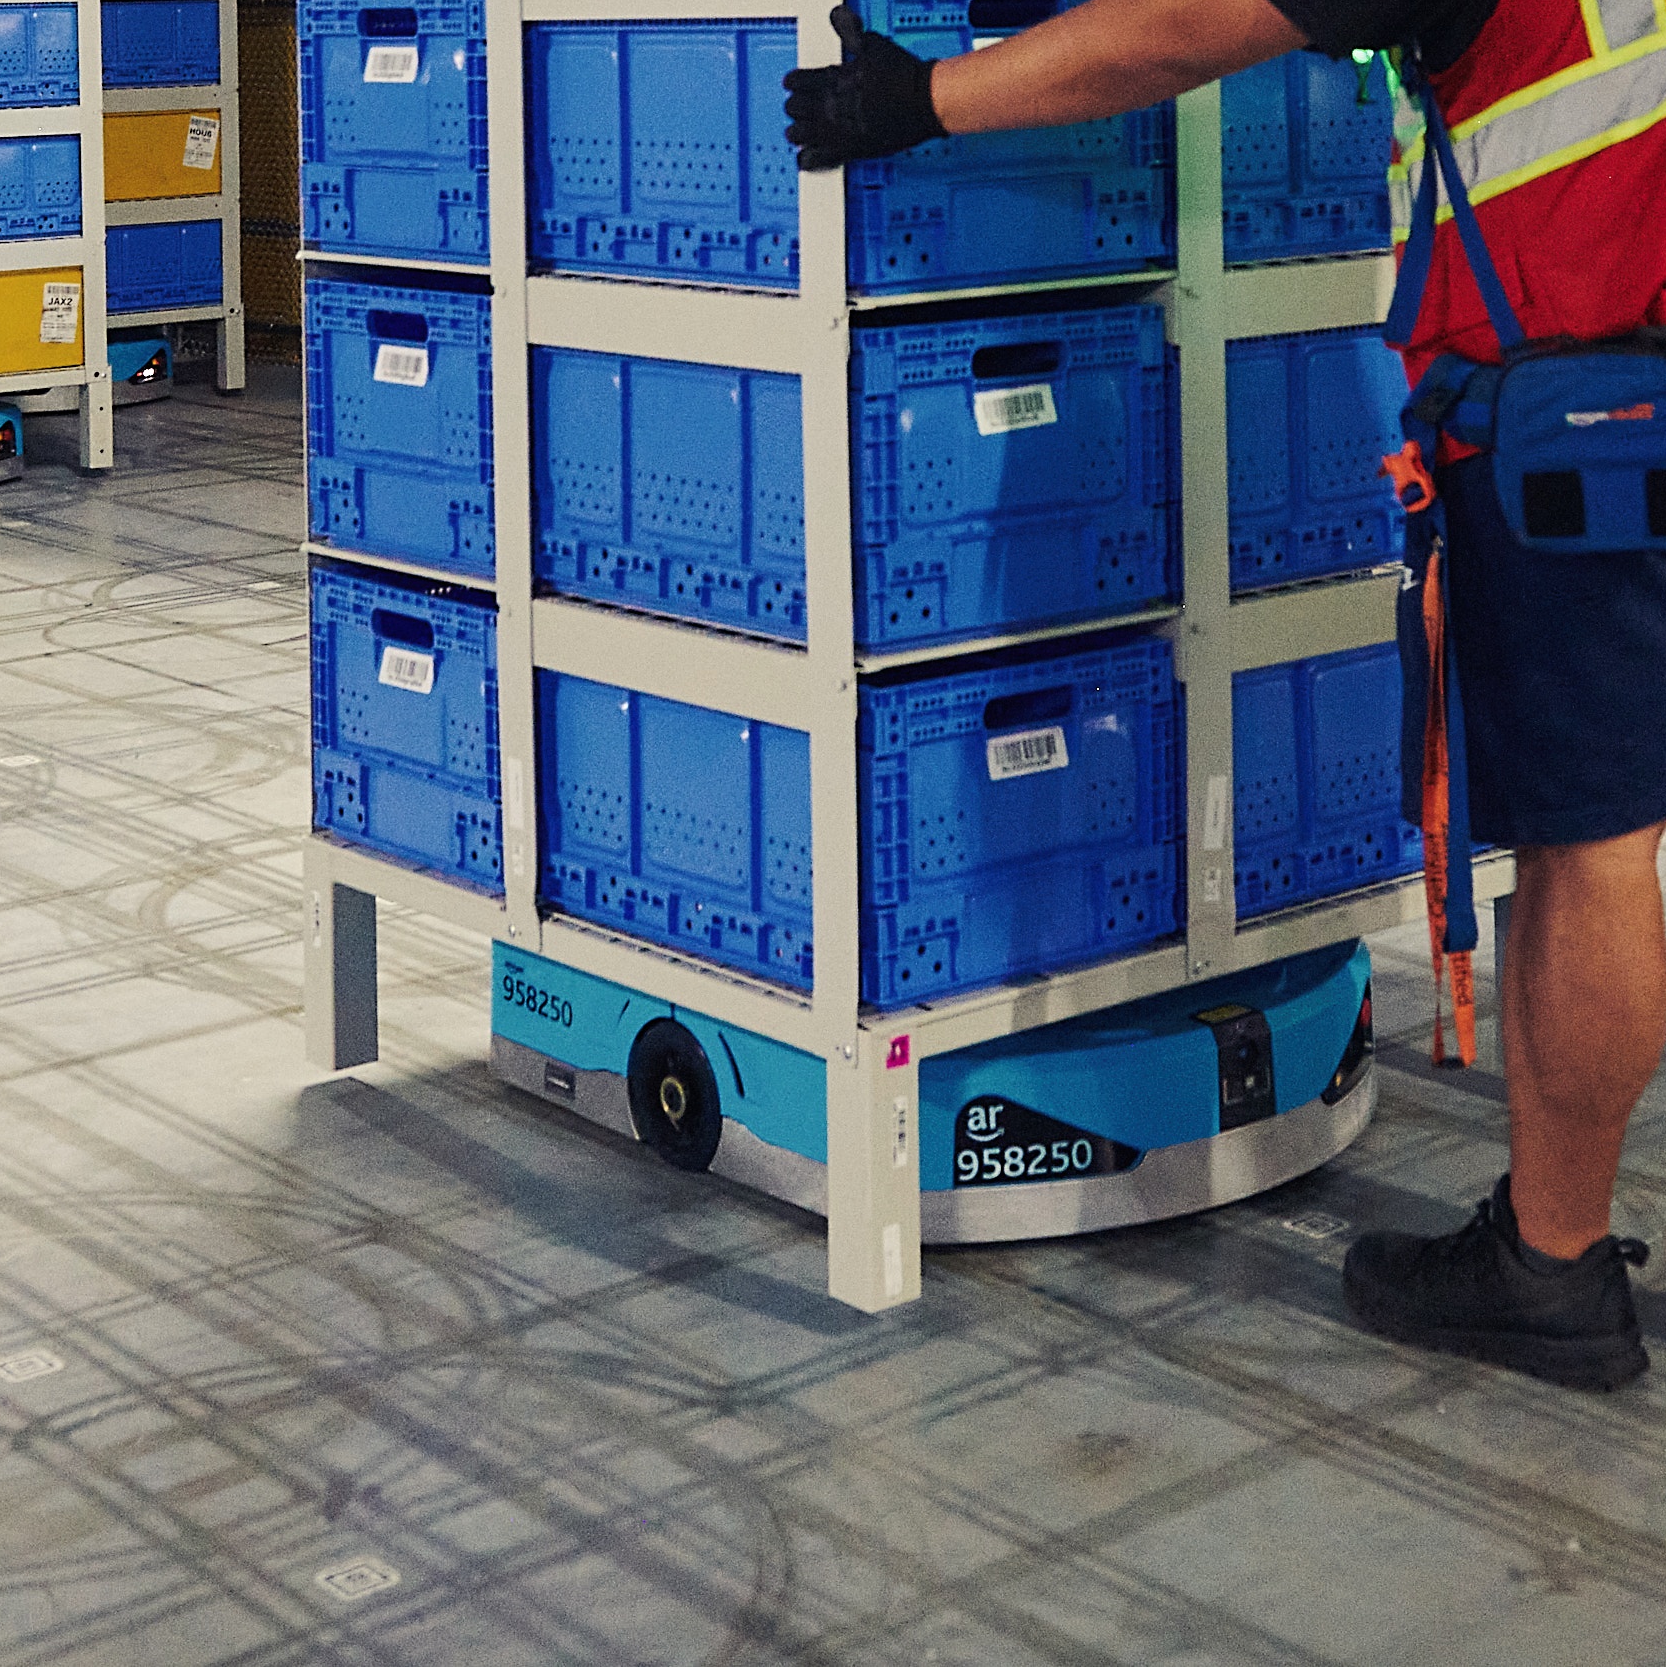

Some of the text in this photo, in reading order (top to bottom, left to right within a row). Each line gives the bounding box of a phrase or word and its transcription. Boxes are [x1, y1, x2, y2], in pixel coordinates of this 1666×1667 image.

[48, 297, 73, 306] JAX2
[502, 975, 573, 1028] 958250
[966, 1103, 1005, 1132] ar
[957, 1138, 1093, 1182] 958250
